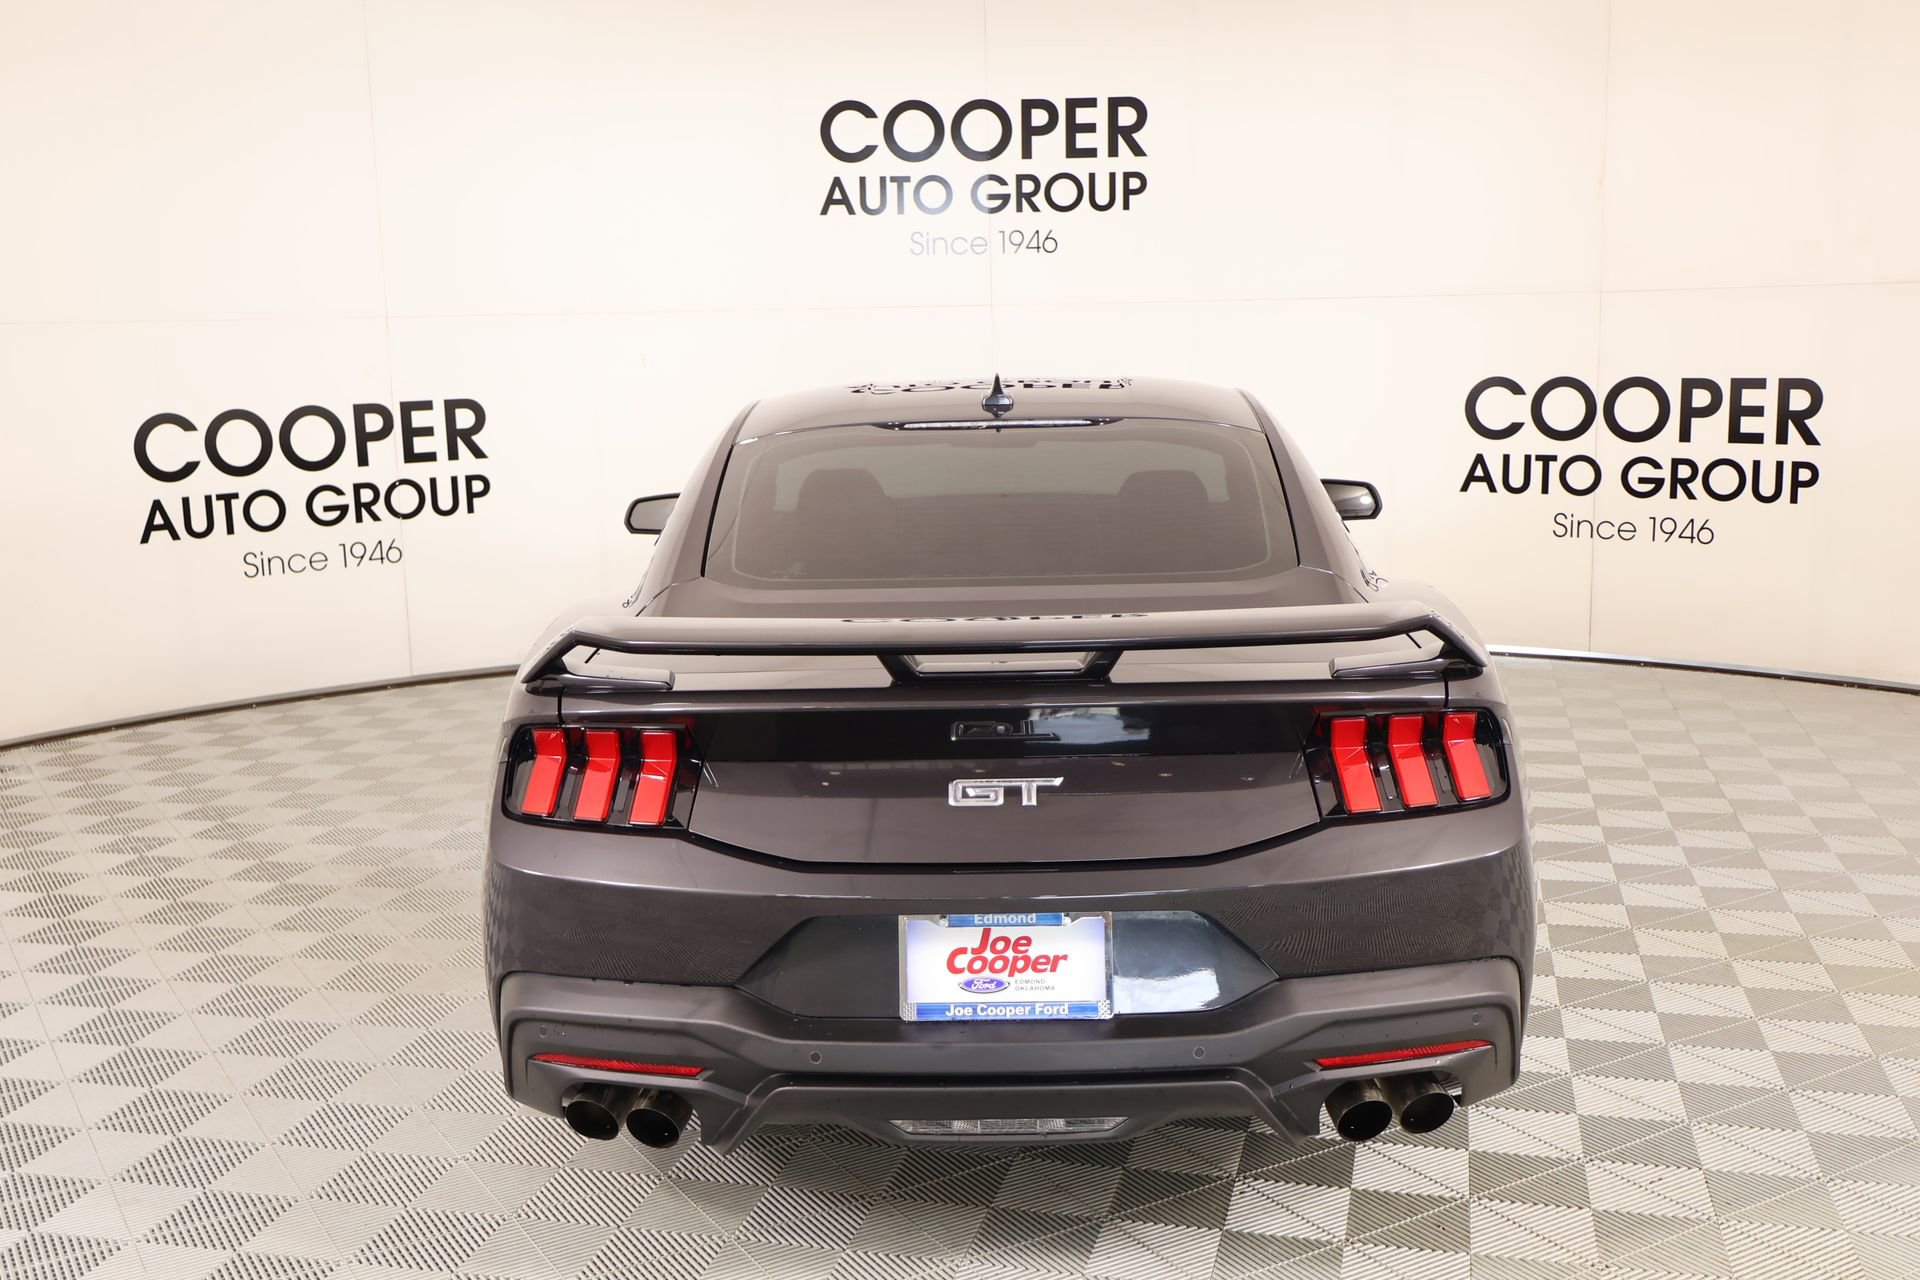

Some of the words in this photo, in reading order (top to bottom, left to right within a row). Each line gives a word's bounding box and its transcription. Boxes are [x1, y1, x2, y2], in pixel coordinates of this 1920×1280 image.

[820, 96, 1148, 163] COOPER
[820, 174, 953, 216] AUTO
[970, 171, 1148, 214] GROUP
[910, 230, 988, 256] Since
[998, 229, 1058, 253] 1946
[1465, 376, 1824, 446] COOPER
[133, 398, 489, 483] COOPER
[1459, 453, 1602, 497] AUTO
[1620, 456, 1820, 504] GROUP
[140, 489, 287, 544] AUTO
[305, 473, 491, 527] GROUP
[1552, 512, 1637, 541] Since
[1648, 516, 1715, 545] 1946
[243, 551, 328, 578] Since
[338, 538, 403, 568] 1946
[948, 776, 1064, 806] GT
[974, 913, 1037, 924] Edmond
[971, 928, 1032, 955] Joe
[946, 947, 1068, 977] Cooper
[971, 978, 998, 989] Ford
[946, 1004, 973, 1016] Joe
[976, 1004, 1031, 1018] Cooper
[1035, 1003, 1069, 1016] Ford
